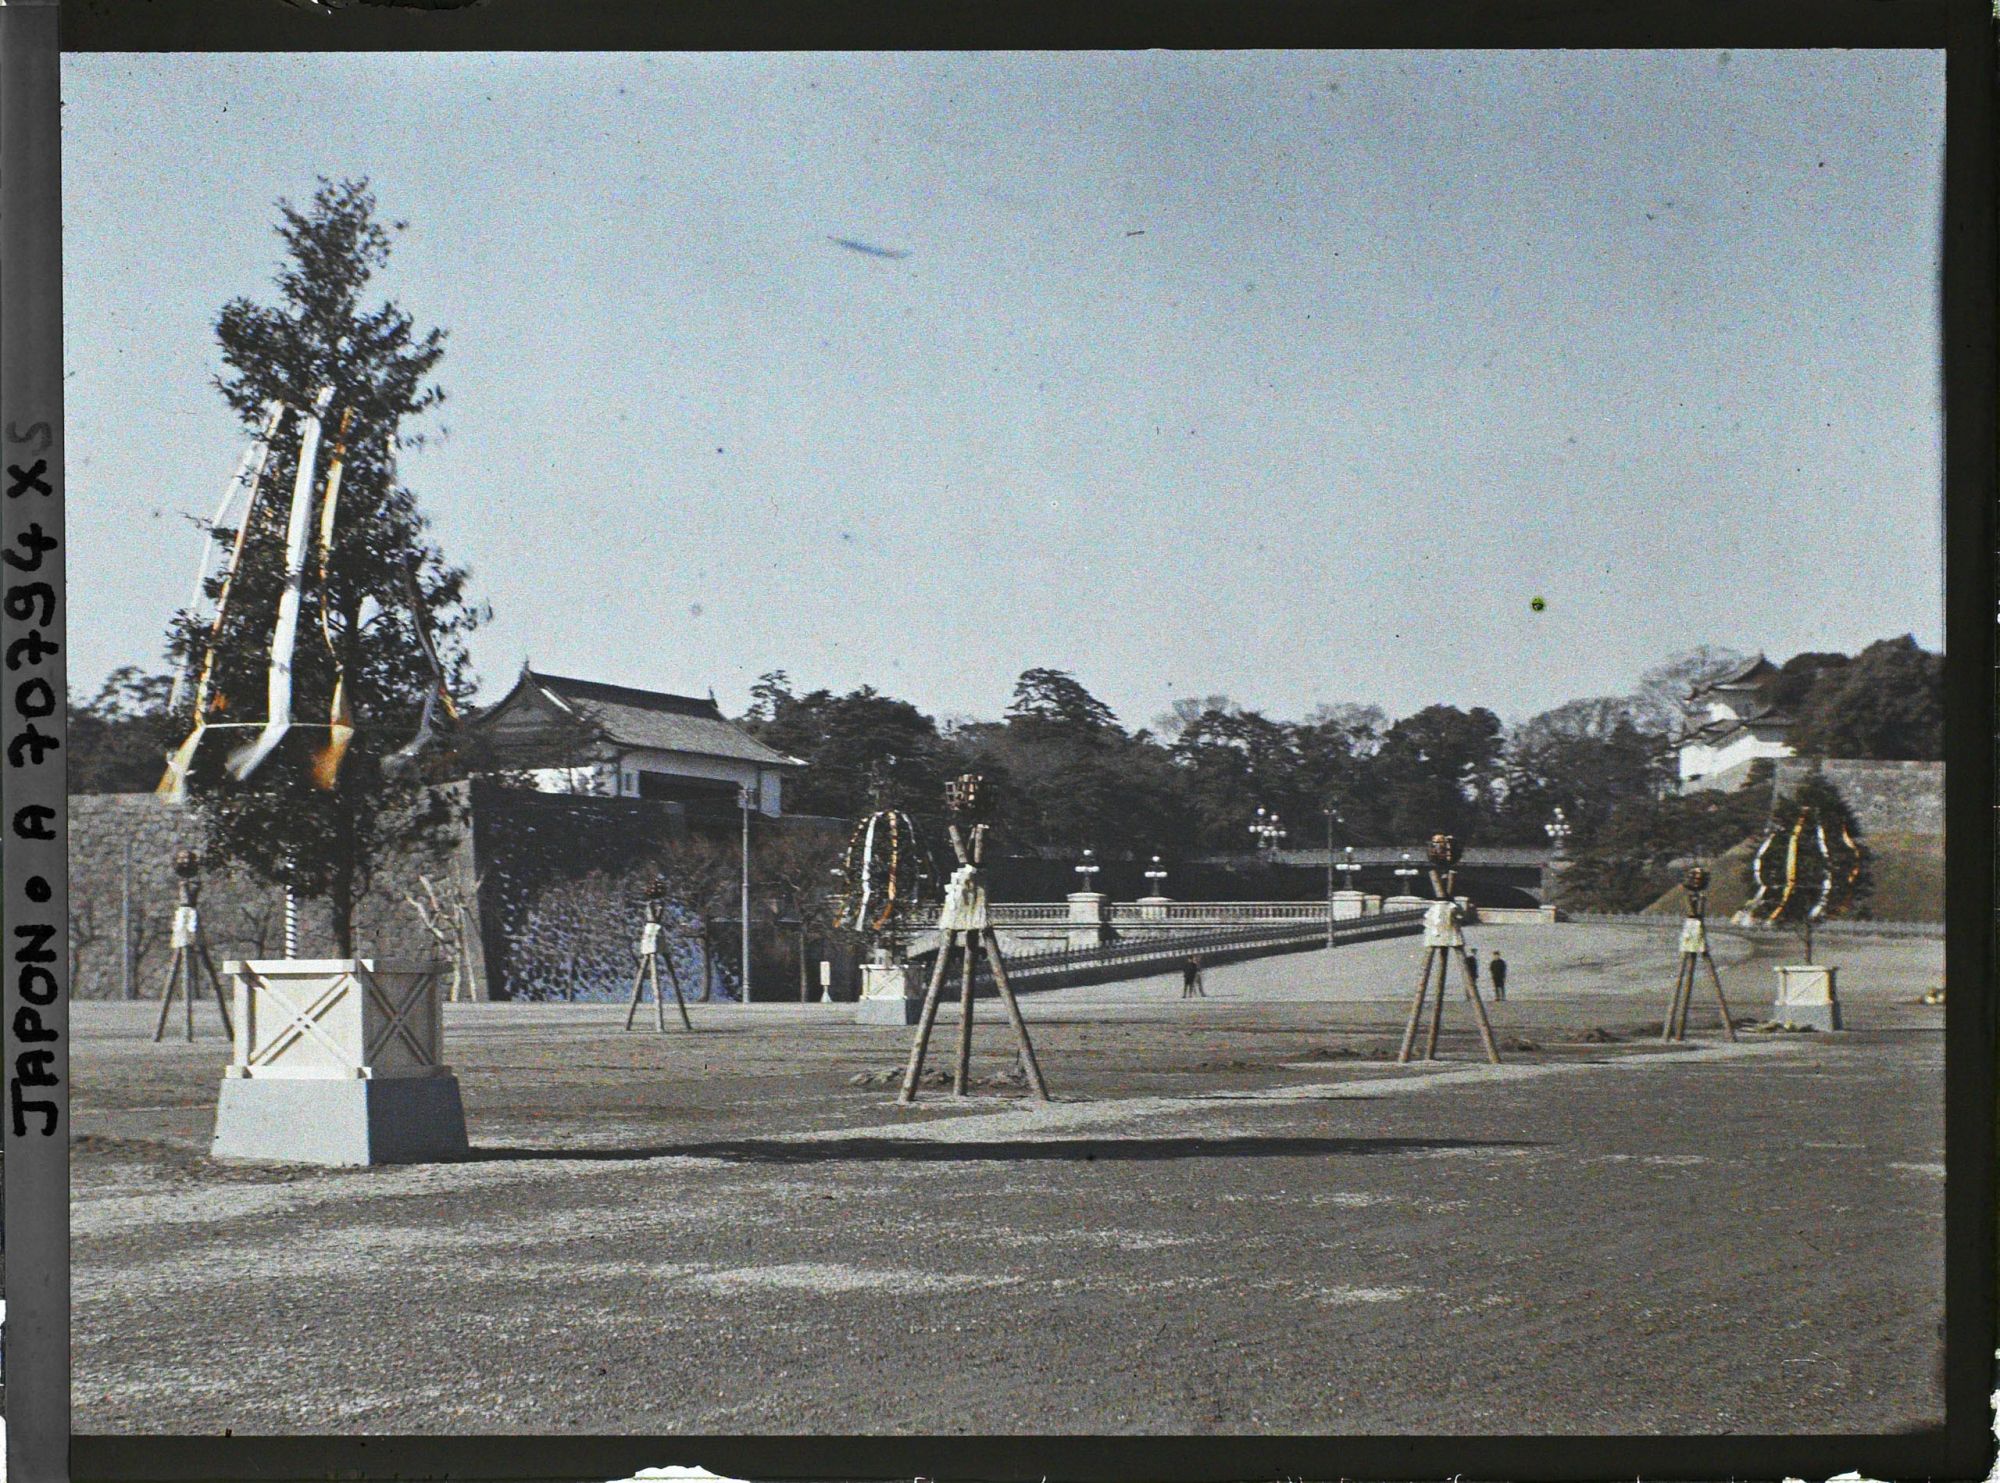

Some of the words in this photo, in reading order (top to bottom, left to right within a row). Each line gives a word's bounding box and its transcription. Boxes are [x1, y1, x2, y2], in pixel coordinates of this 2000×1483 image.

[3, 522, 60, 769] 70794
[12, 804, 57, 842] A
[11, 923, 60, 1138] JAPON
